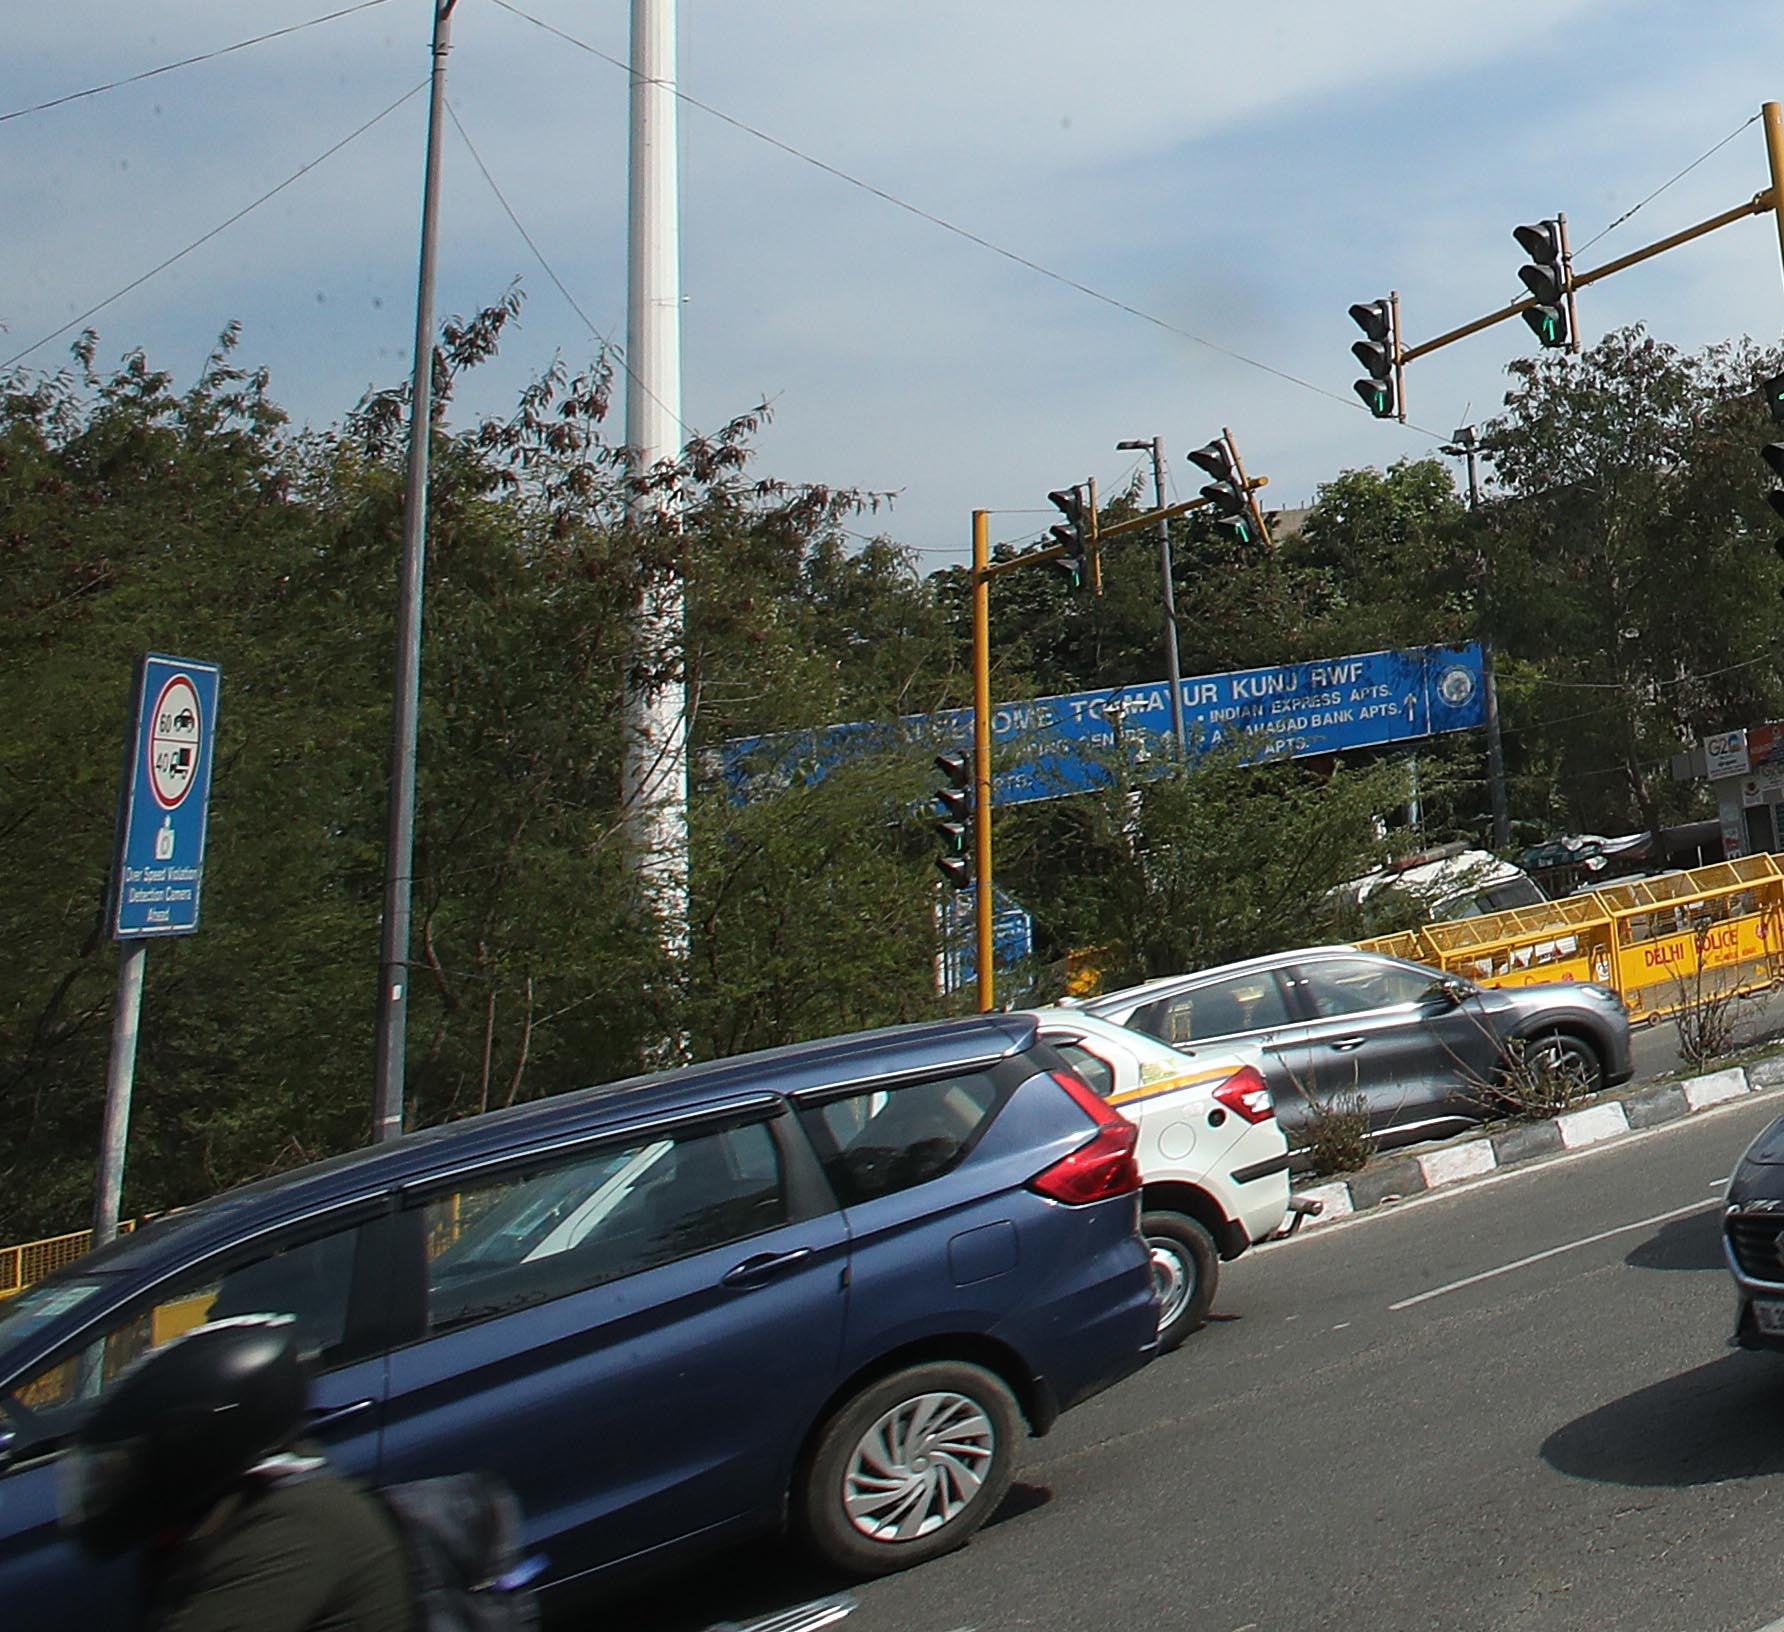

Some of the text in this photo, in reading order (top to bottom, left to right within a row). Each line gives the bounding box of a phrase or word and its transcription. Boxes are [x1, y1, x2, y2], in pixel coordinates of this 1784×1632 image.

[1069, 697, 1108, 723] TO
[1232, 671, 1298, 701] KUNJ
[1209, 704, 1263, 724] INDIAN
[1271, 691, 1342, 715] EXPRESS
[1350, 683, 1393, 702] APTS.
[160, 713, 172, 733] 60
[1212, 701, 1402, 744] AAHABAD BANK APTS.
[1263, 734, 1310, 756] APTS.
[156, 752, 168, 773] 40
[129, 886, 192, 903] Detection Camera
[1644, 942, 1685, 968] DELHI
[1694, 928, 1739, 954] POLICE
